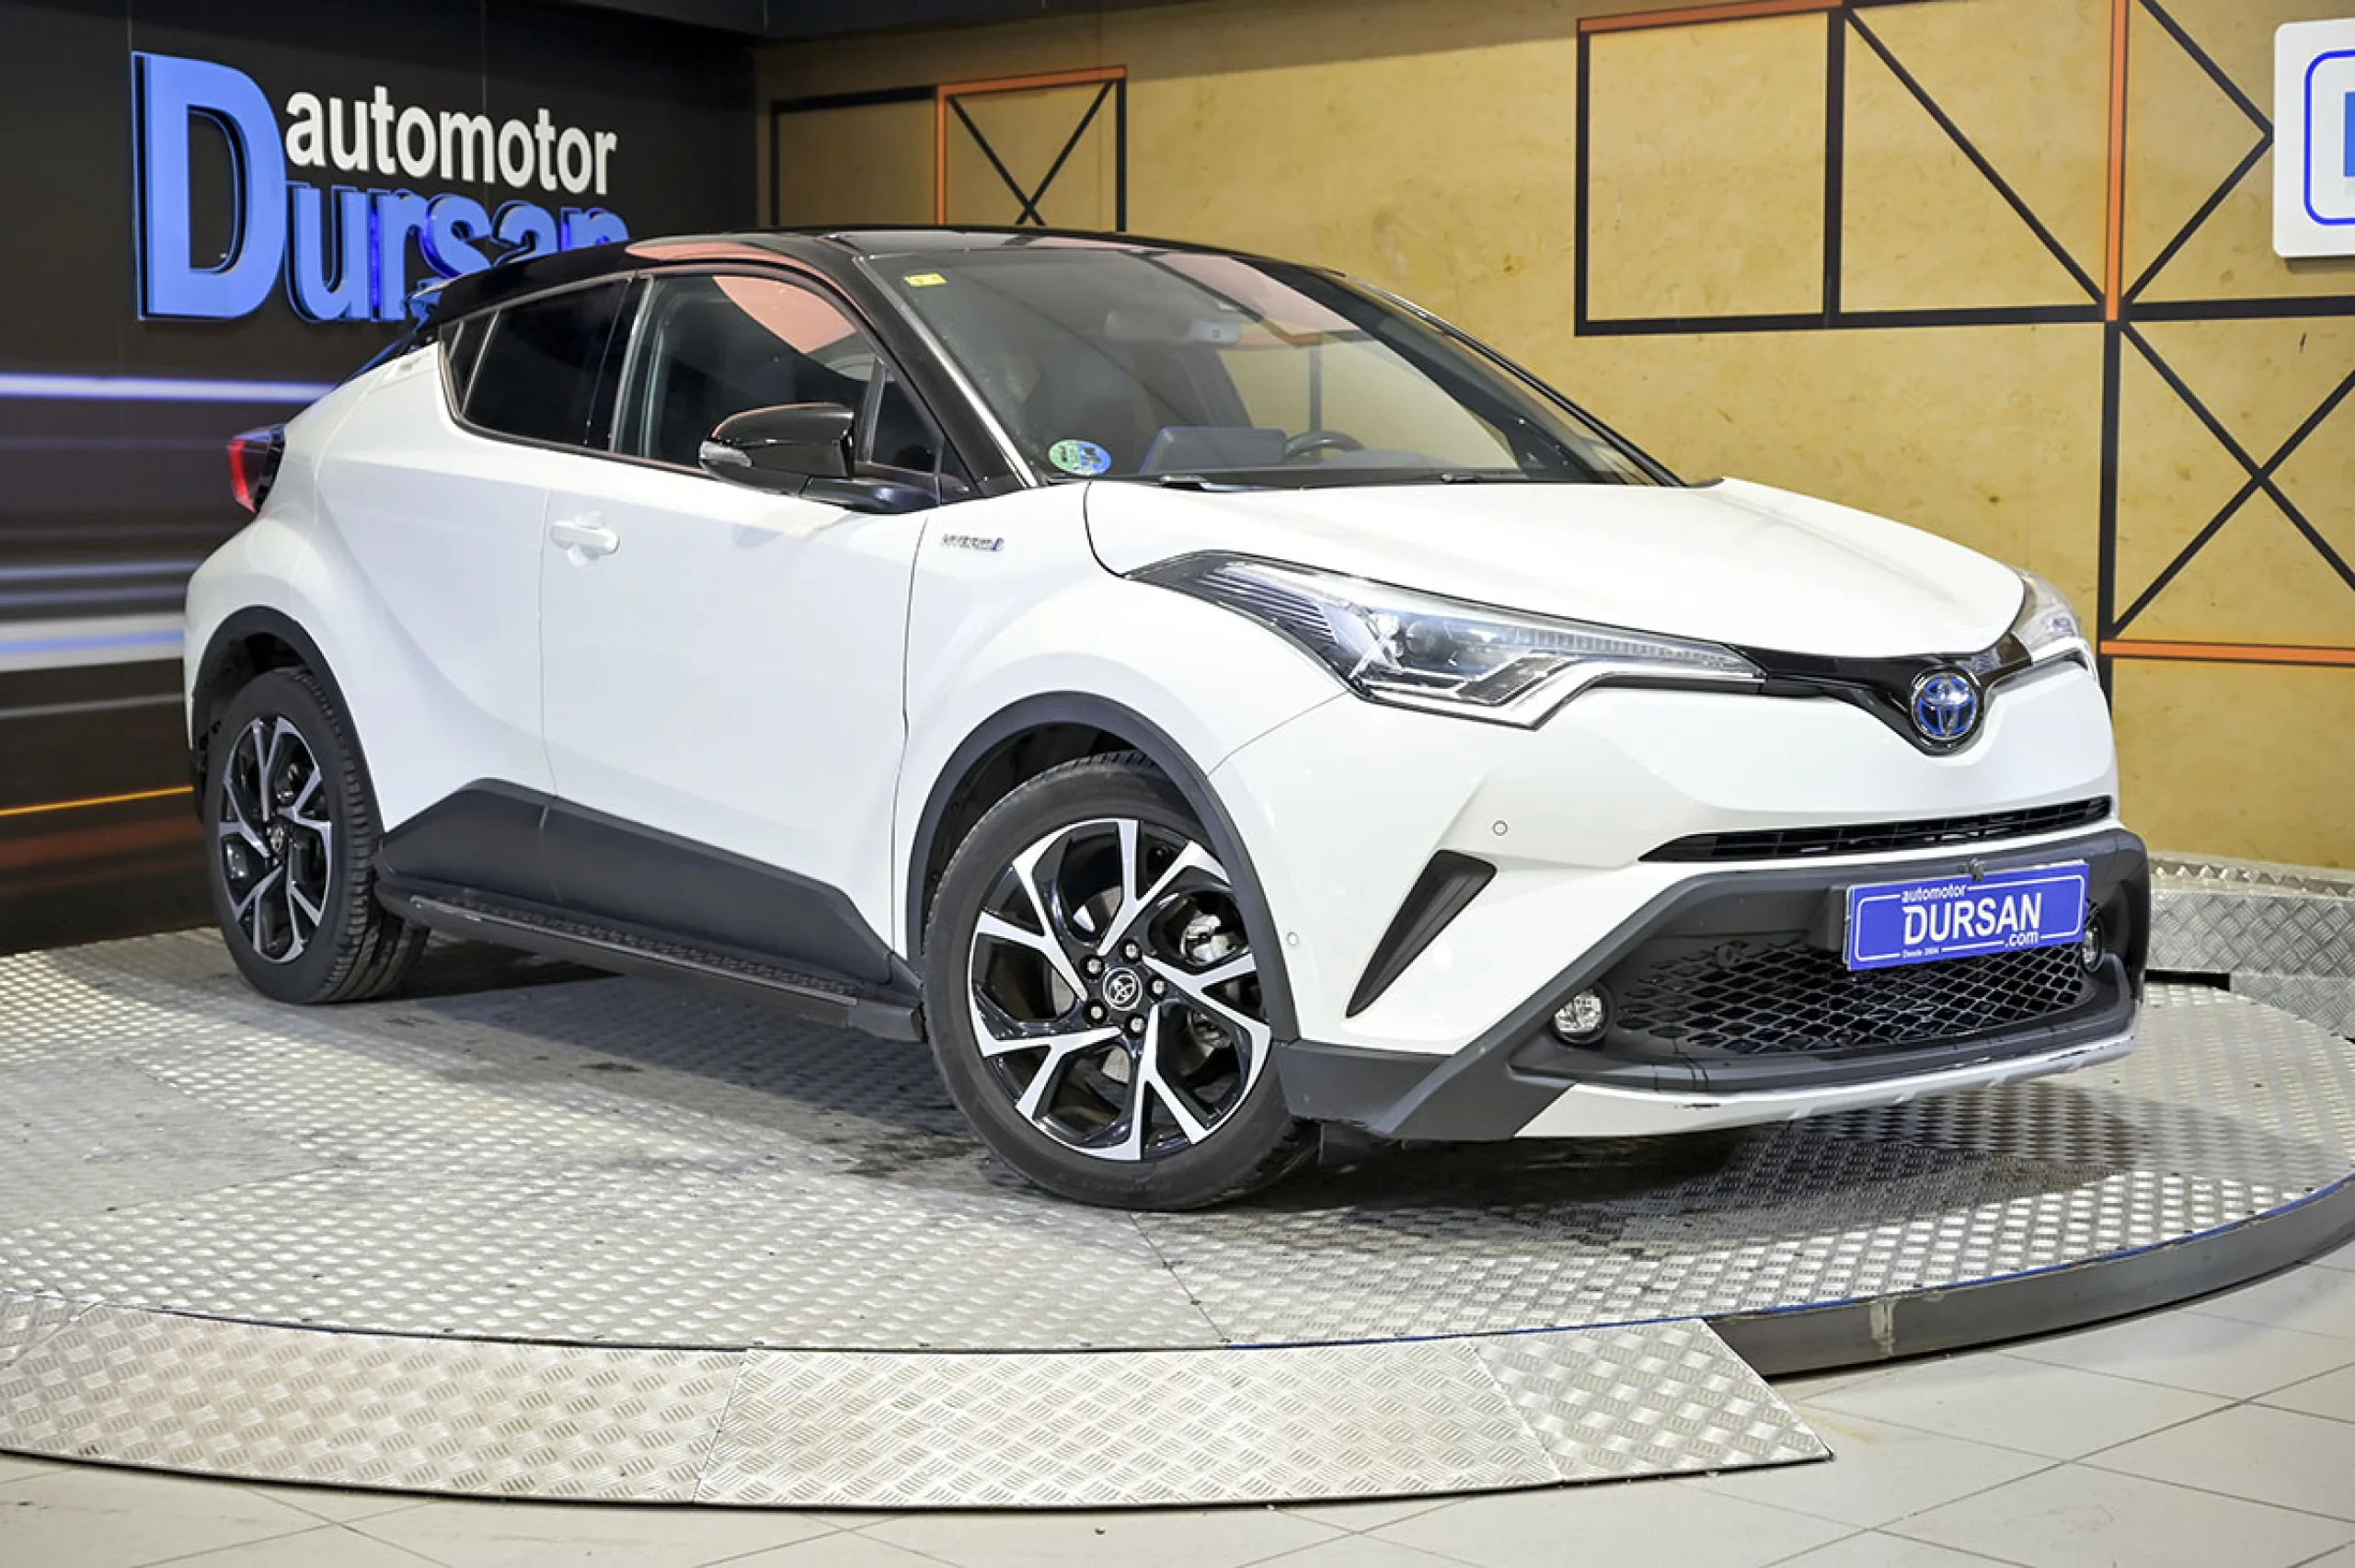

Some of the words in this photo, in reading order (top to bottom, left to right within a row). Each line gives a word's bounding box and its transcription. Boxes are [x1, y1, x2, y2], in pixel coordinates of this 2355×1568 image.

[285, 86, 617, 195] automotor
[1901, 884, 1967, 903] automotor
[1901, 892, 2042, 945] DURSAN
[2004, 932, 2039, 948] .com
